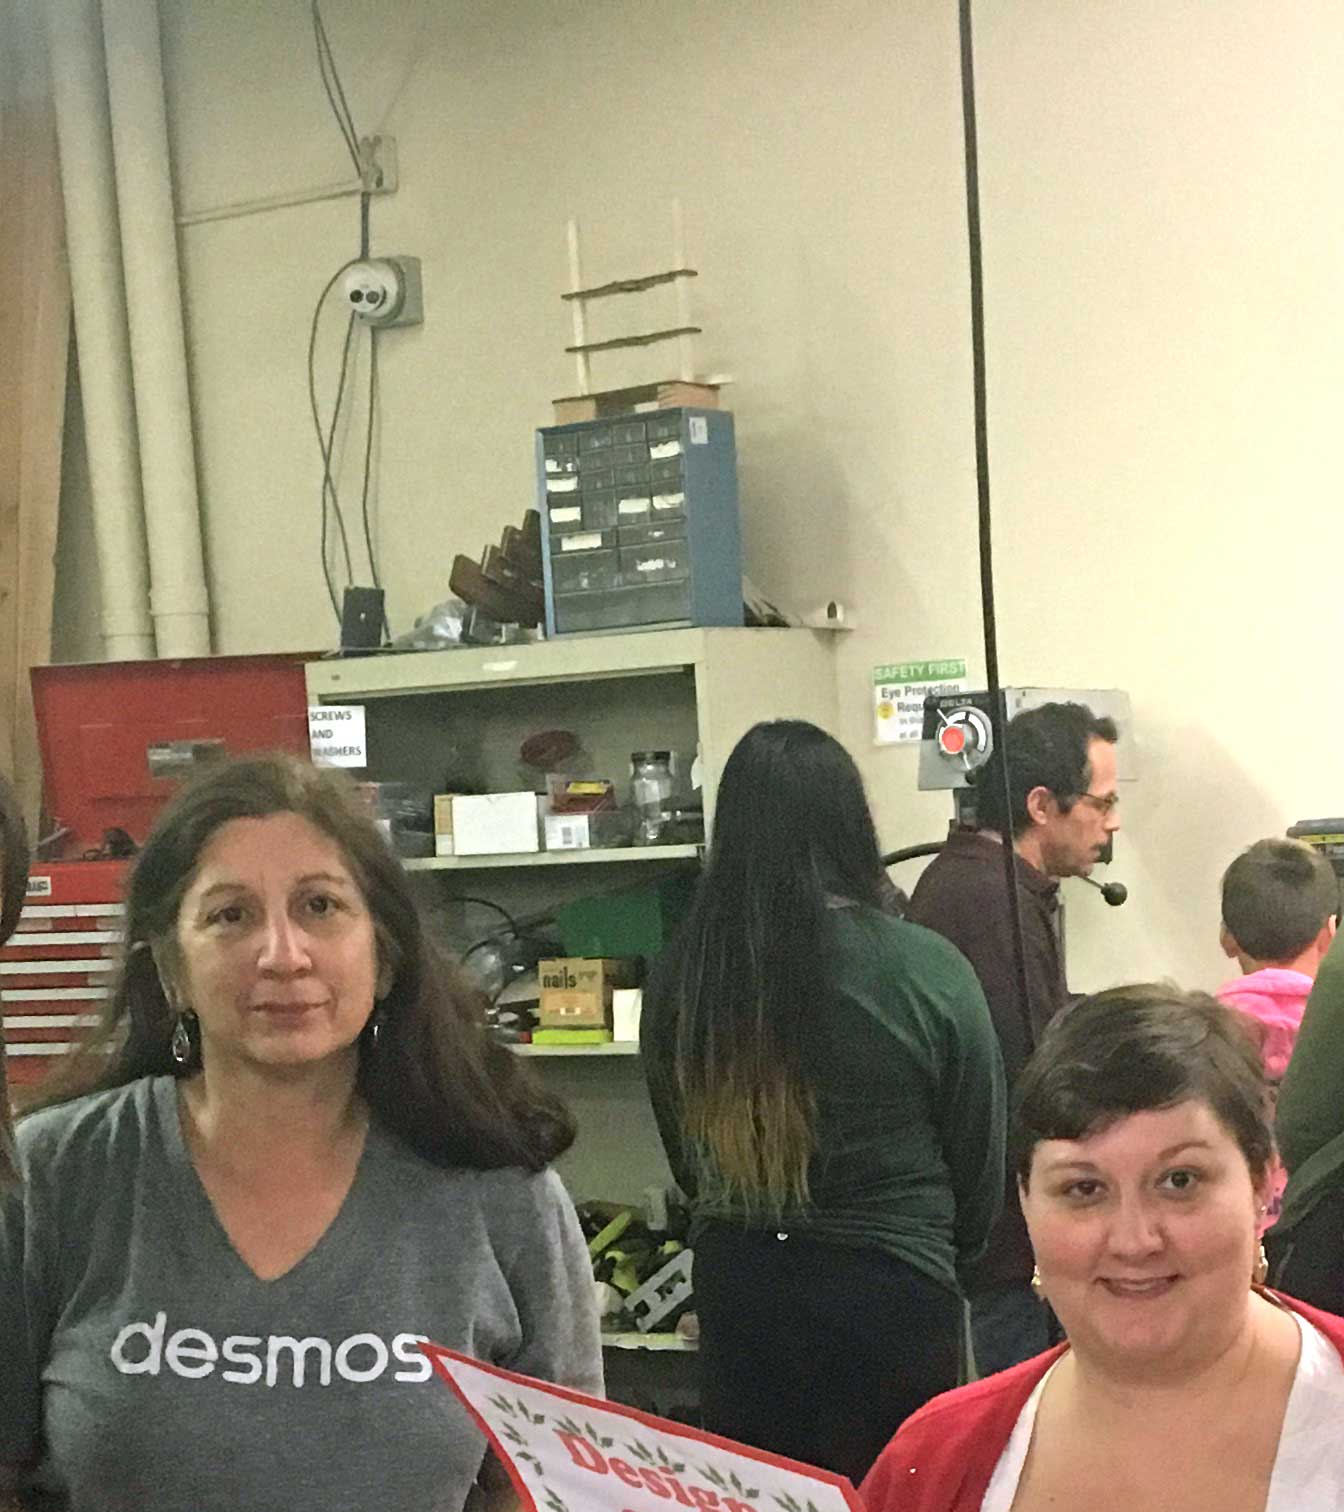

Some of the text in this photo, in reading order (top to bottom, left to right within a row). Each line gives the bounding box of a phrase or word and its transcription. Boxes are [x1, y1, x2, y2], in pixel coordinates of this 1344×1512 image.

[874, 660, 965, 680] SAFETY FIRST
[881, 683, 960, 699] Eye Protection
[310, 710, 352, 721] SCREWS
[312, 729, 334, 739] AND
[543, 966, 577, 989] nails
[111, 1311, 433, 1388] desmos
